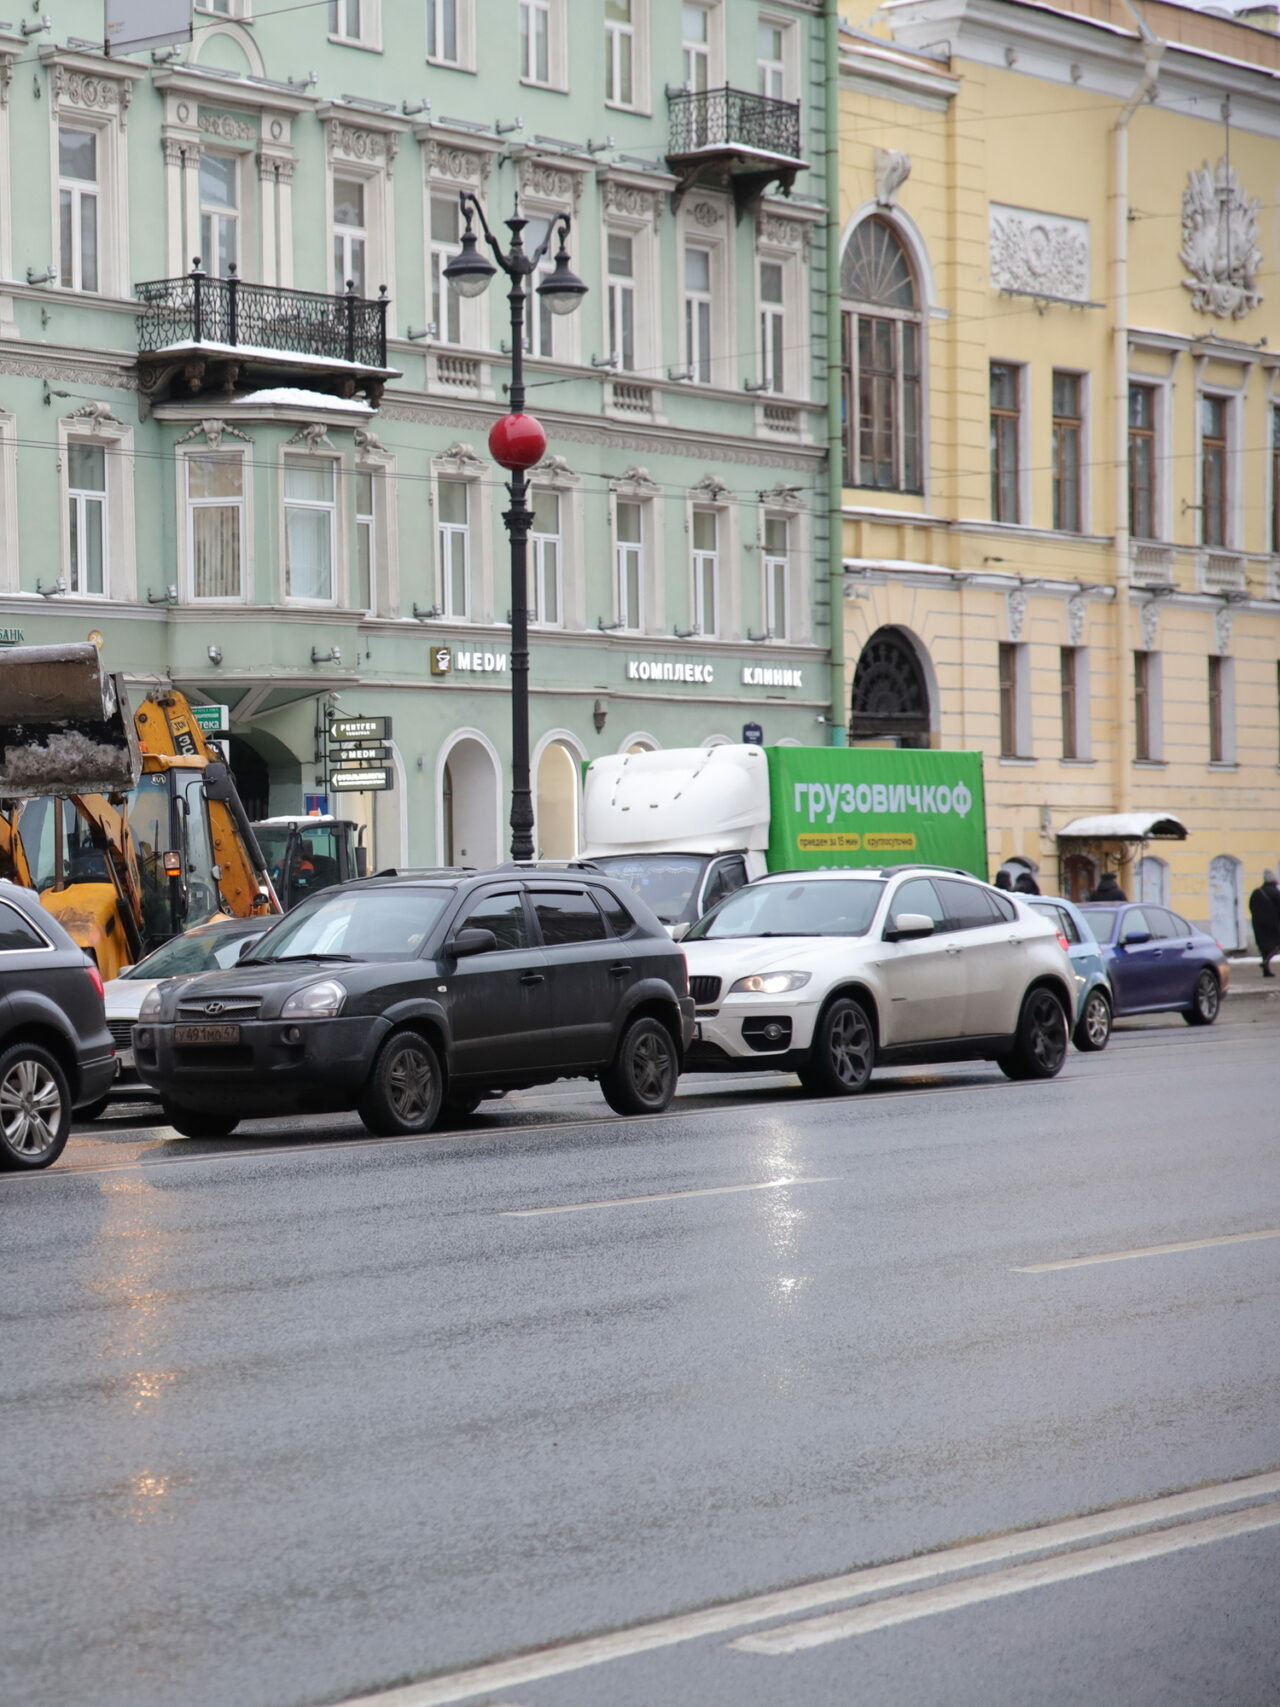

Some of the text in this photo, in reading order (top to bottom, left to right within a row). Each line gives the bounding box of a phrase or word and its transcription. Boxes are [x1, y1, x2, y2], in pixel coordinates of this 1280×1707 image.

[629, 661, 803, 688] КОМПЛЕКС КЛИНИК
[793, 779, 973, 824] грузовичкоф
